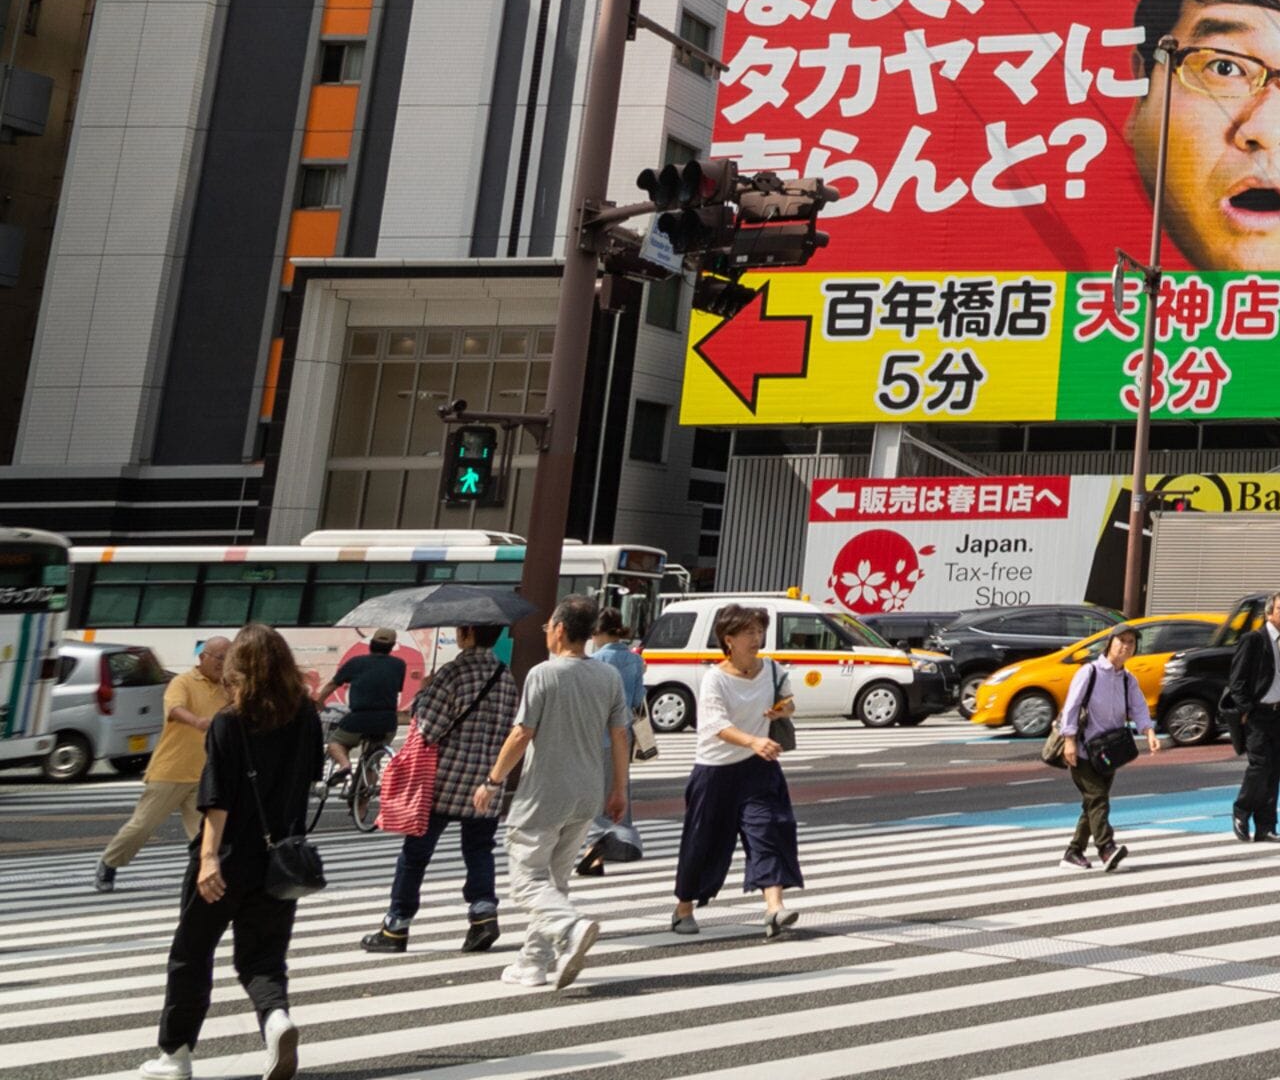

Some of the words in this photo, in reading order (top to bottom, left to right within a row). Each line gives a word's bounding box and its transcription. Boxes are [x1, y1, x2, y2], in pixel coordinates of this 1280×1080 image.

[719, 22, 1150, 124] タカヤマに
[825, 279, 1052, 338] 百年橋店
[877, 351, 984, 413] 5分
[1123, 348, 1229, 412] 3分
[858, 484, 1062, 514] 販売は春日店へ
[955, 534, 1034, 554] Japan.
[944, 561, 1033, 582] Tax-free
[975, 587, 1031, 607] Shop
